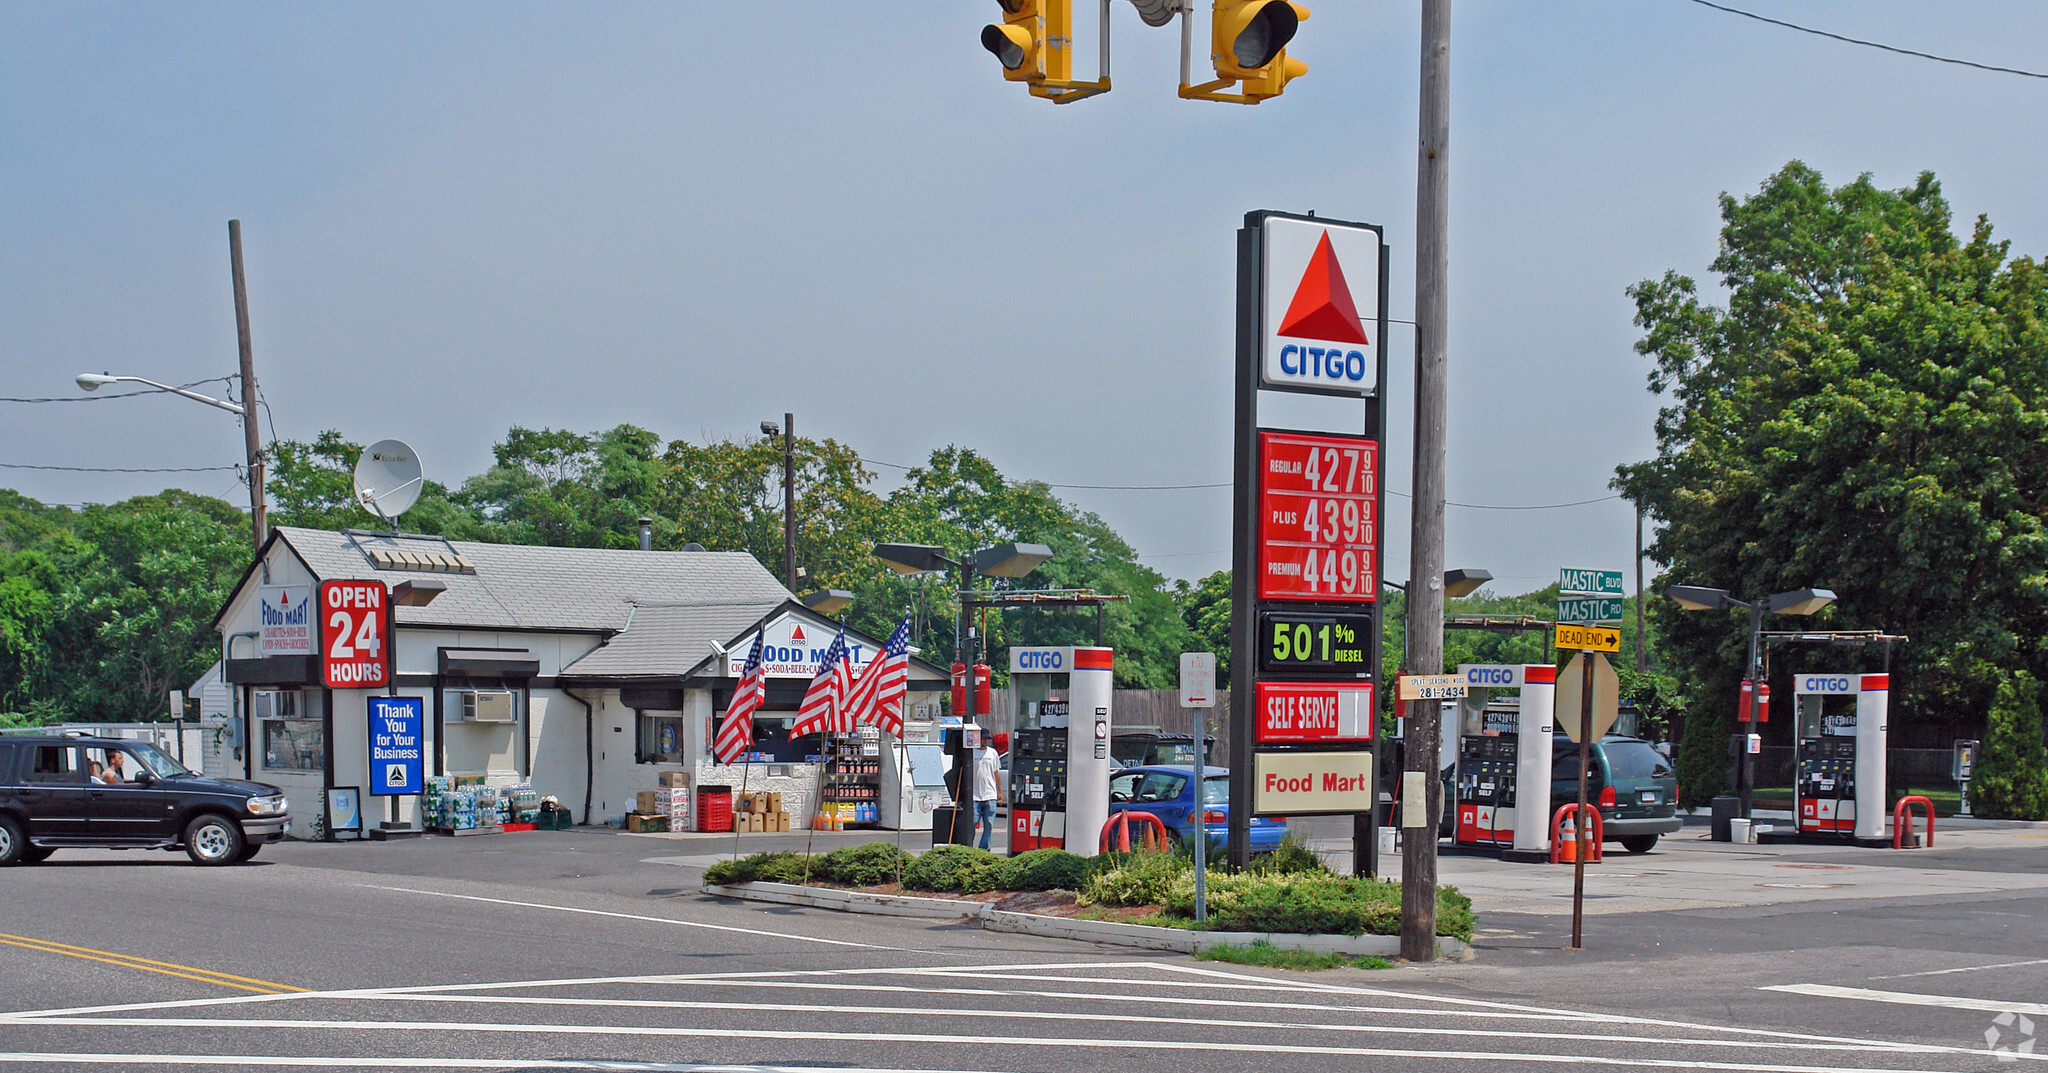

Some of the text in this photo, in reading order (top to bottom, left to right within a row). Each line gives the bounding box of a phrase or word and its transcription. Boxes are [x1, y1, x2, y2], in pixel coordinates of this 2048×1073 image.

[1281, 344, 1365, 380] CITGO
[1270, 447, 1359, 492] REGULAR 427
[1273, 499, 1359, 543] PLUS 439
[1268, 548, 1357, 593] PREMIUM 449
[1561, 570, 1621, 591] MASTIC BLVD
[328, 586, 380, 608] OPEN
[262, 596, 308, 625] FOOD MART
[1559, 600, 1621, 620] MASTIC RD
[329, 611, 380, 658] 24
[1273, 623, 1330, 661] 501
[1560, 630, 1603, 645] DEAD END
[762, 645, 803, 662] OOD
[1019, 651, 1062, 668] CITGO
[1335, 650, 1363, 663] DIESEL
[330, 662, 382, 682] HOURS
[1468, 668, 1513, 684] CITGO
[1420, 686, 1465, 698] 281-2434
[1806, 678, 1849, 691] CITGO
[376, 703, 414, 718] Thank
[1267, 696, 1336, 729] SELF SERVE
[385, 719, 406, 733] You
[376, 733, 415, 746] for Your
[374, 746, 418, 759] Business
[1266, 772, 1365, 792] Food Mart
